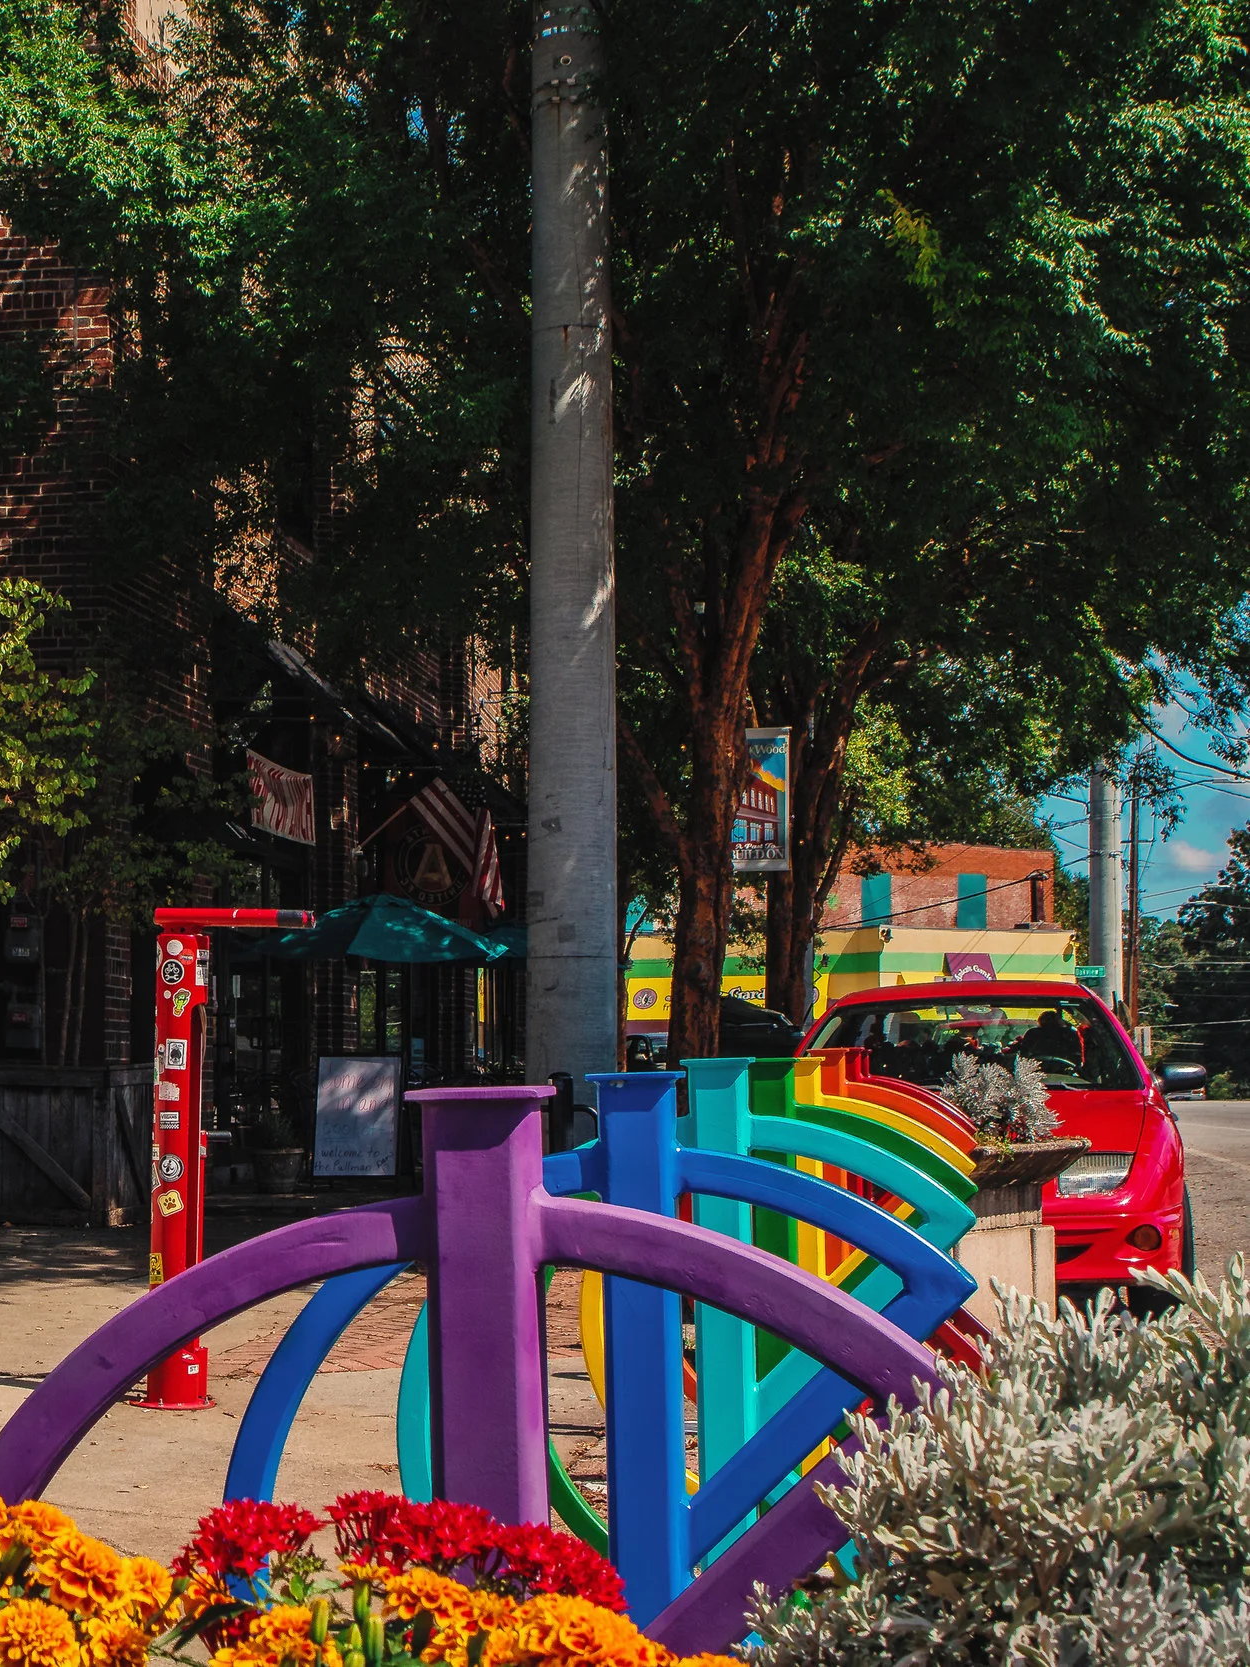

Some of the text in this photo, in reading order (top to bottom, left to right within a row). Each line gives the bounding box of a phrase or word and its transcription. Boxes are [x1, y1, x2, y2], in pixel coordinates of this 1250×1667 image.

[729, 986, 766, 1001] Gard
[321, 1145, 380, 1157] welcome to
